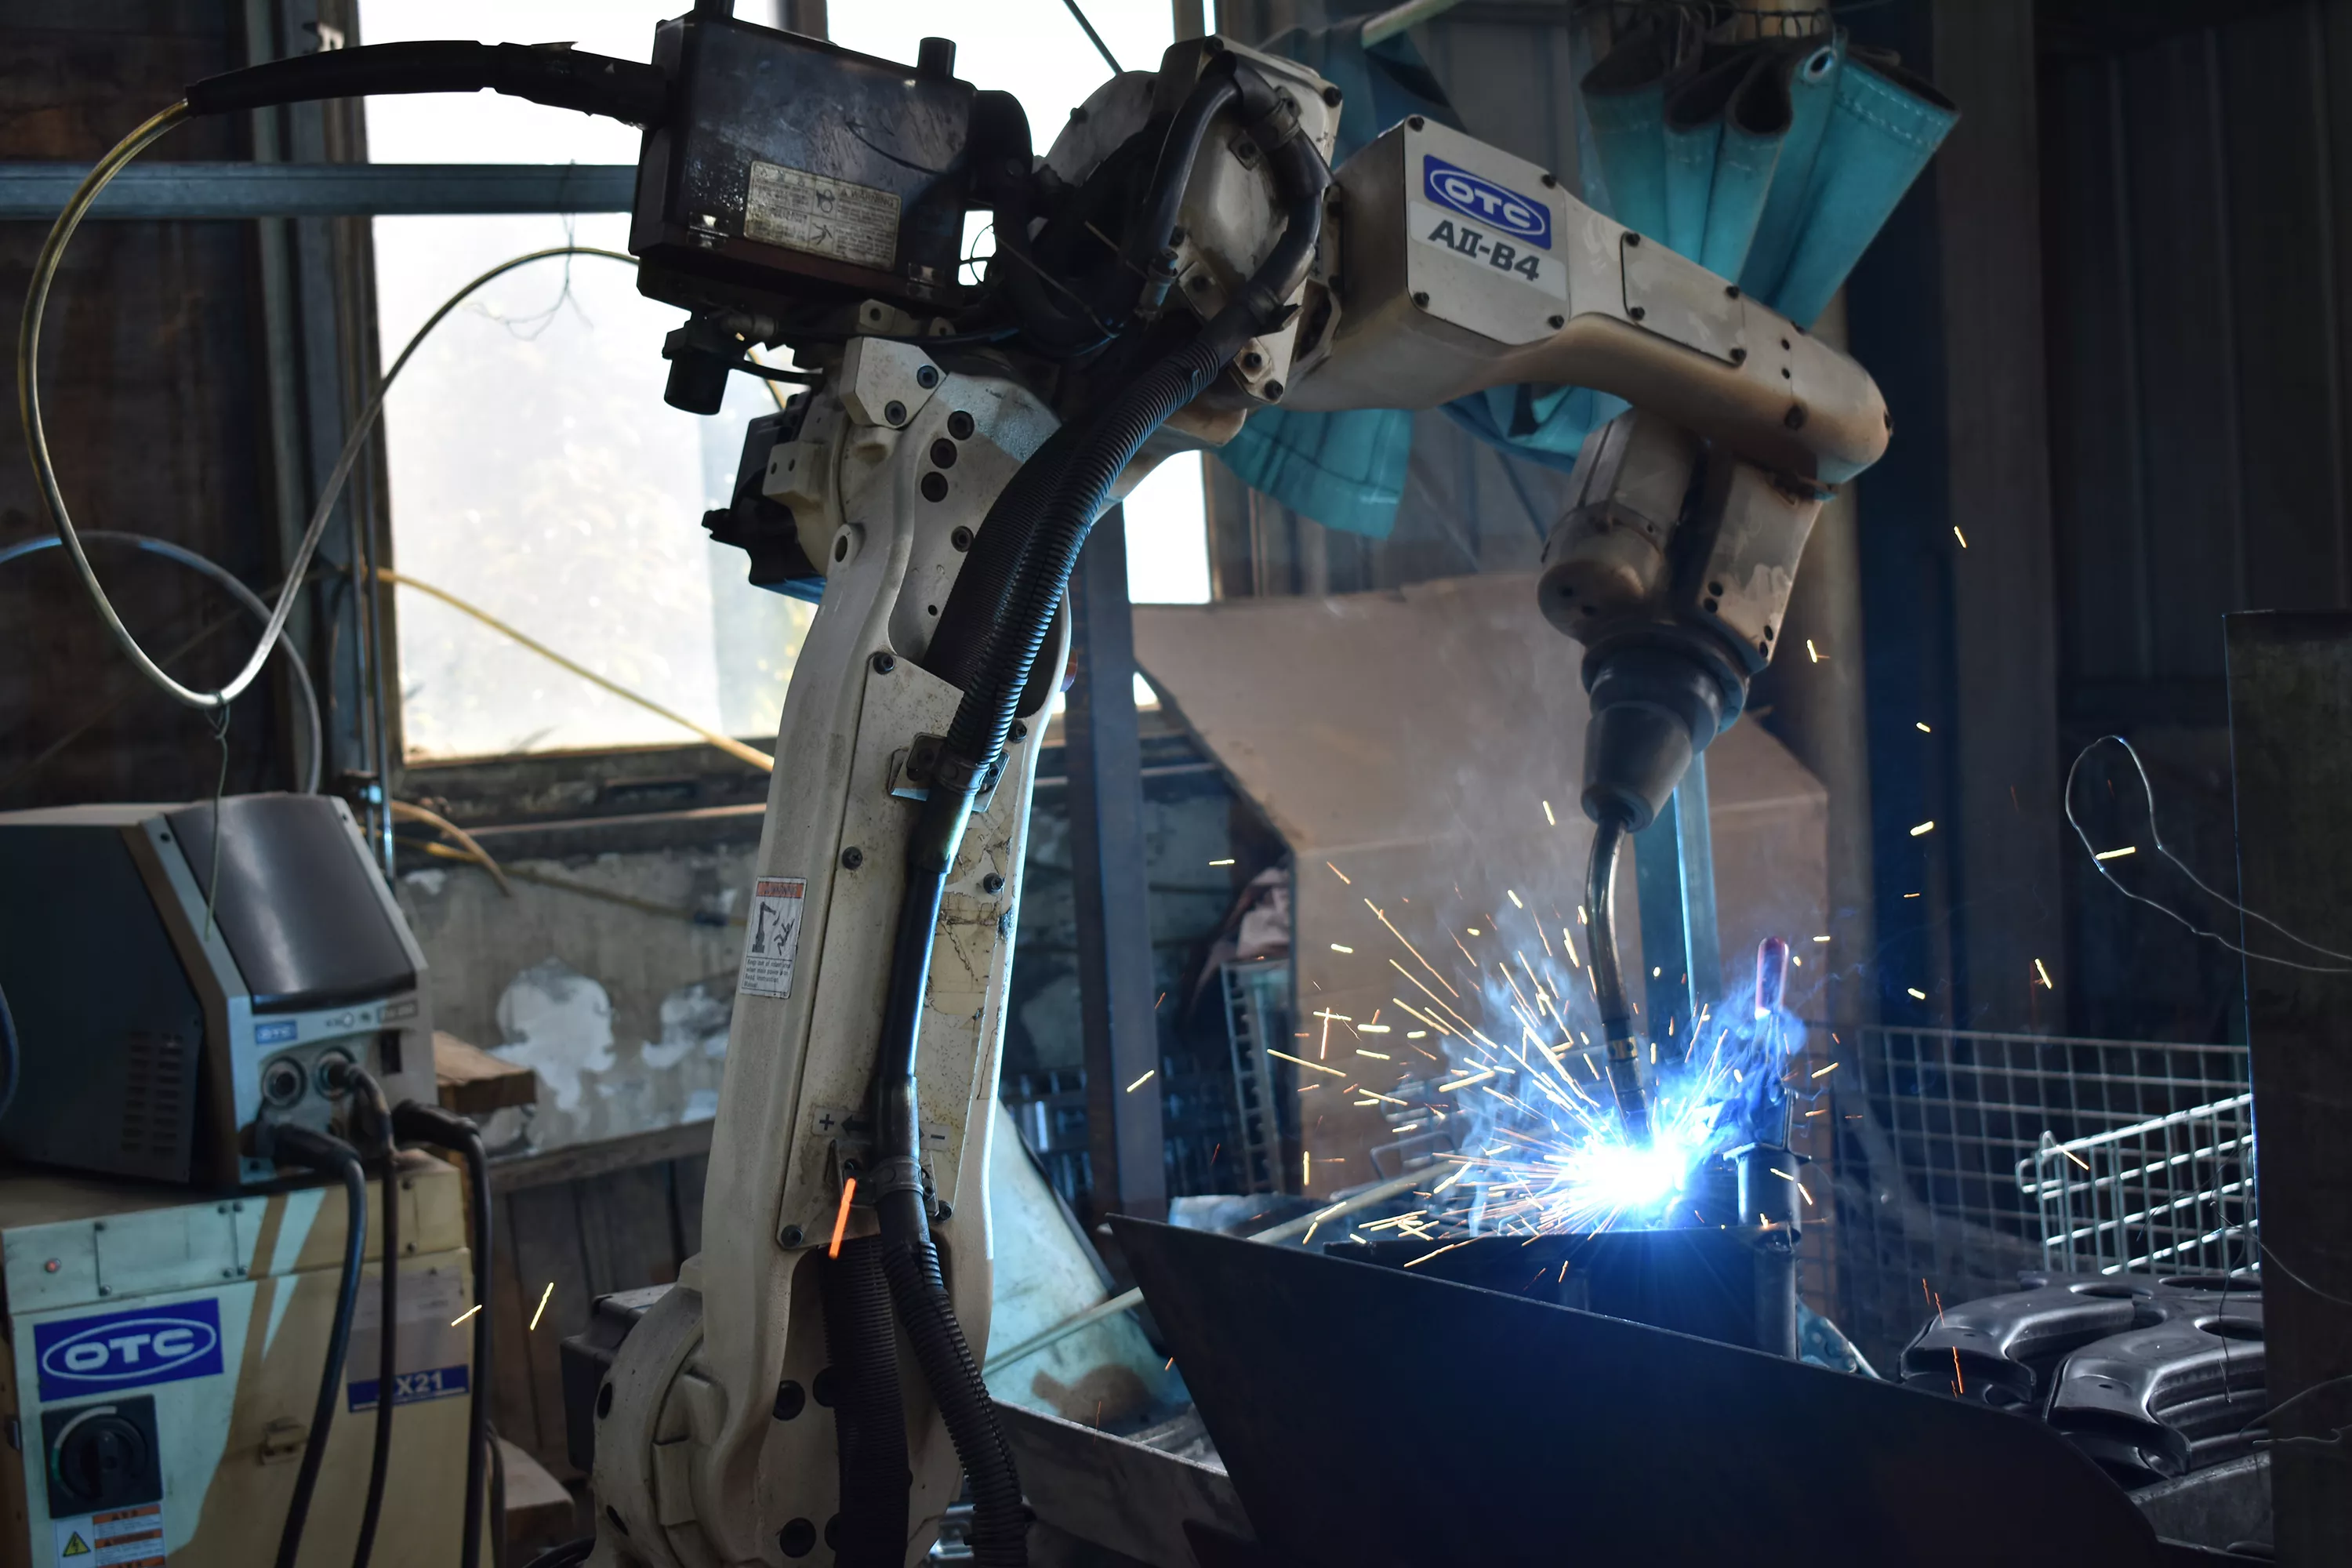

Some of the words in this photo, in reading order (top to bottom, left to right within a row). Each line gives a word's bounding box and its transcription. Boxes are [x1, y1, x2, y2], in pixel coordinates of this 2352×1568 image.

[1445, 178, 1531, 228] OTC
[64, 1328, 196, 1371] OTC
[377, 1370, 445, 1398] X21
